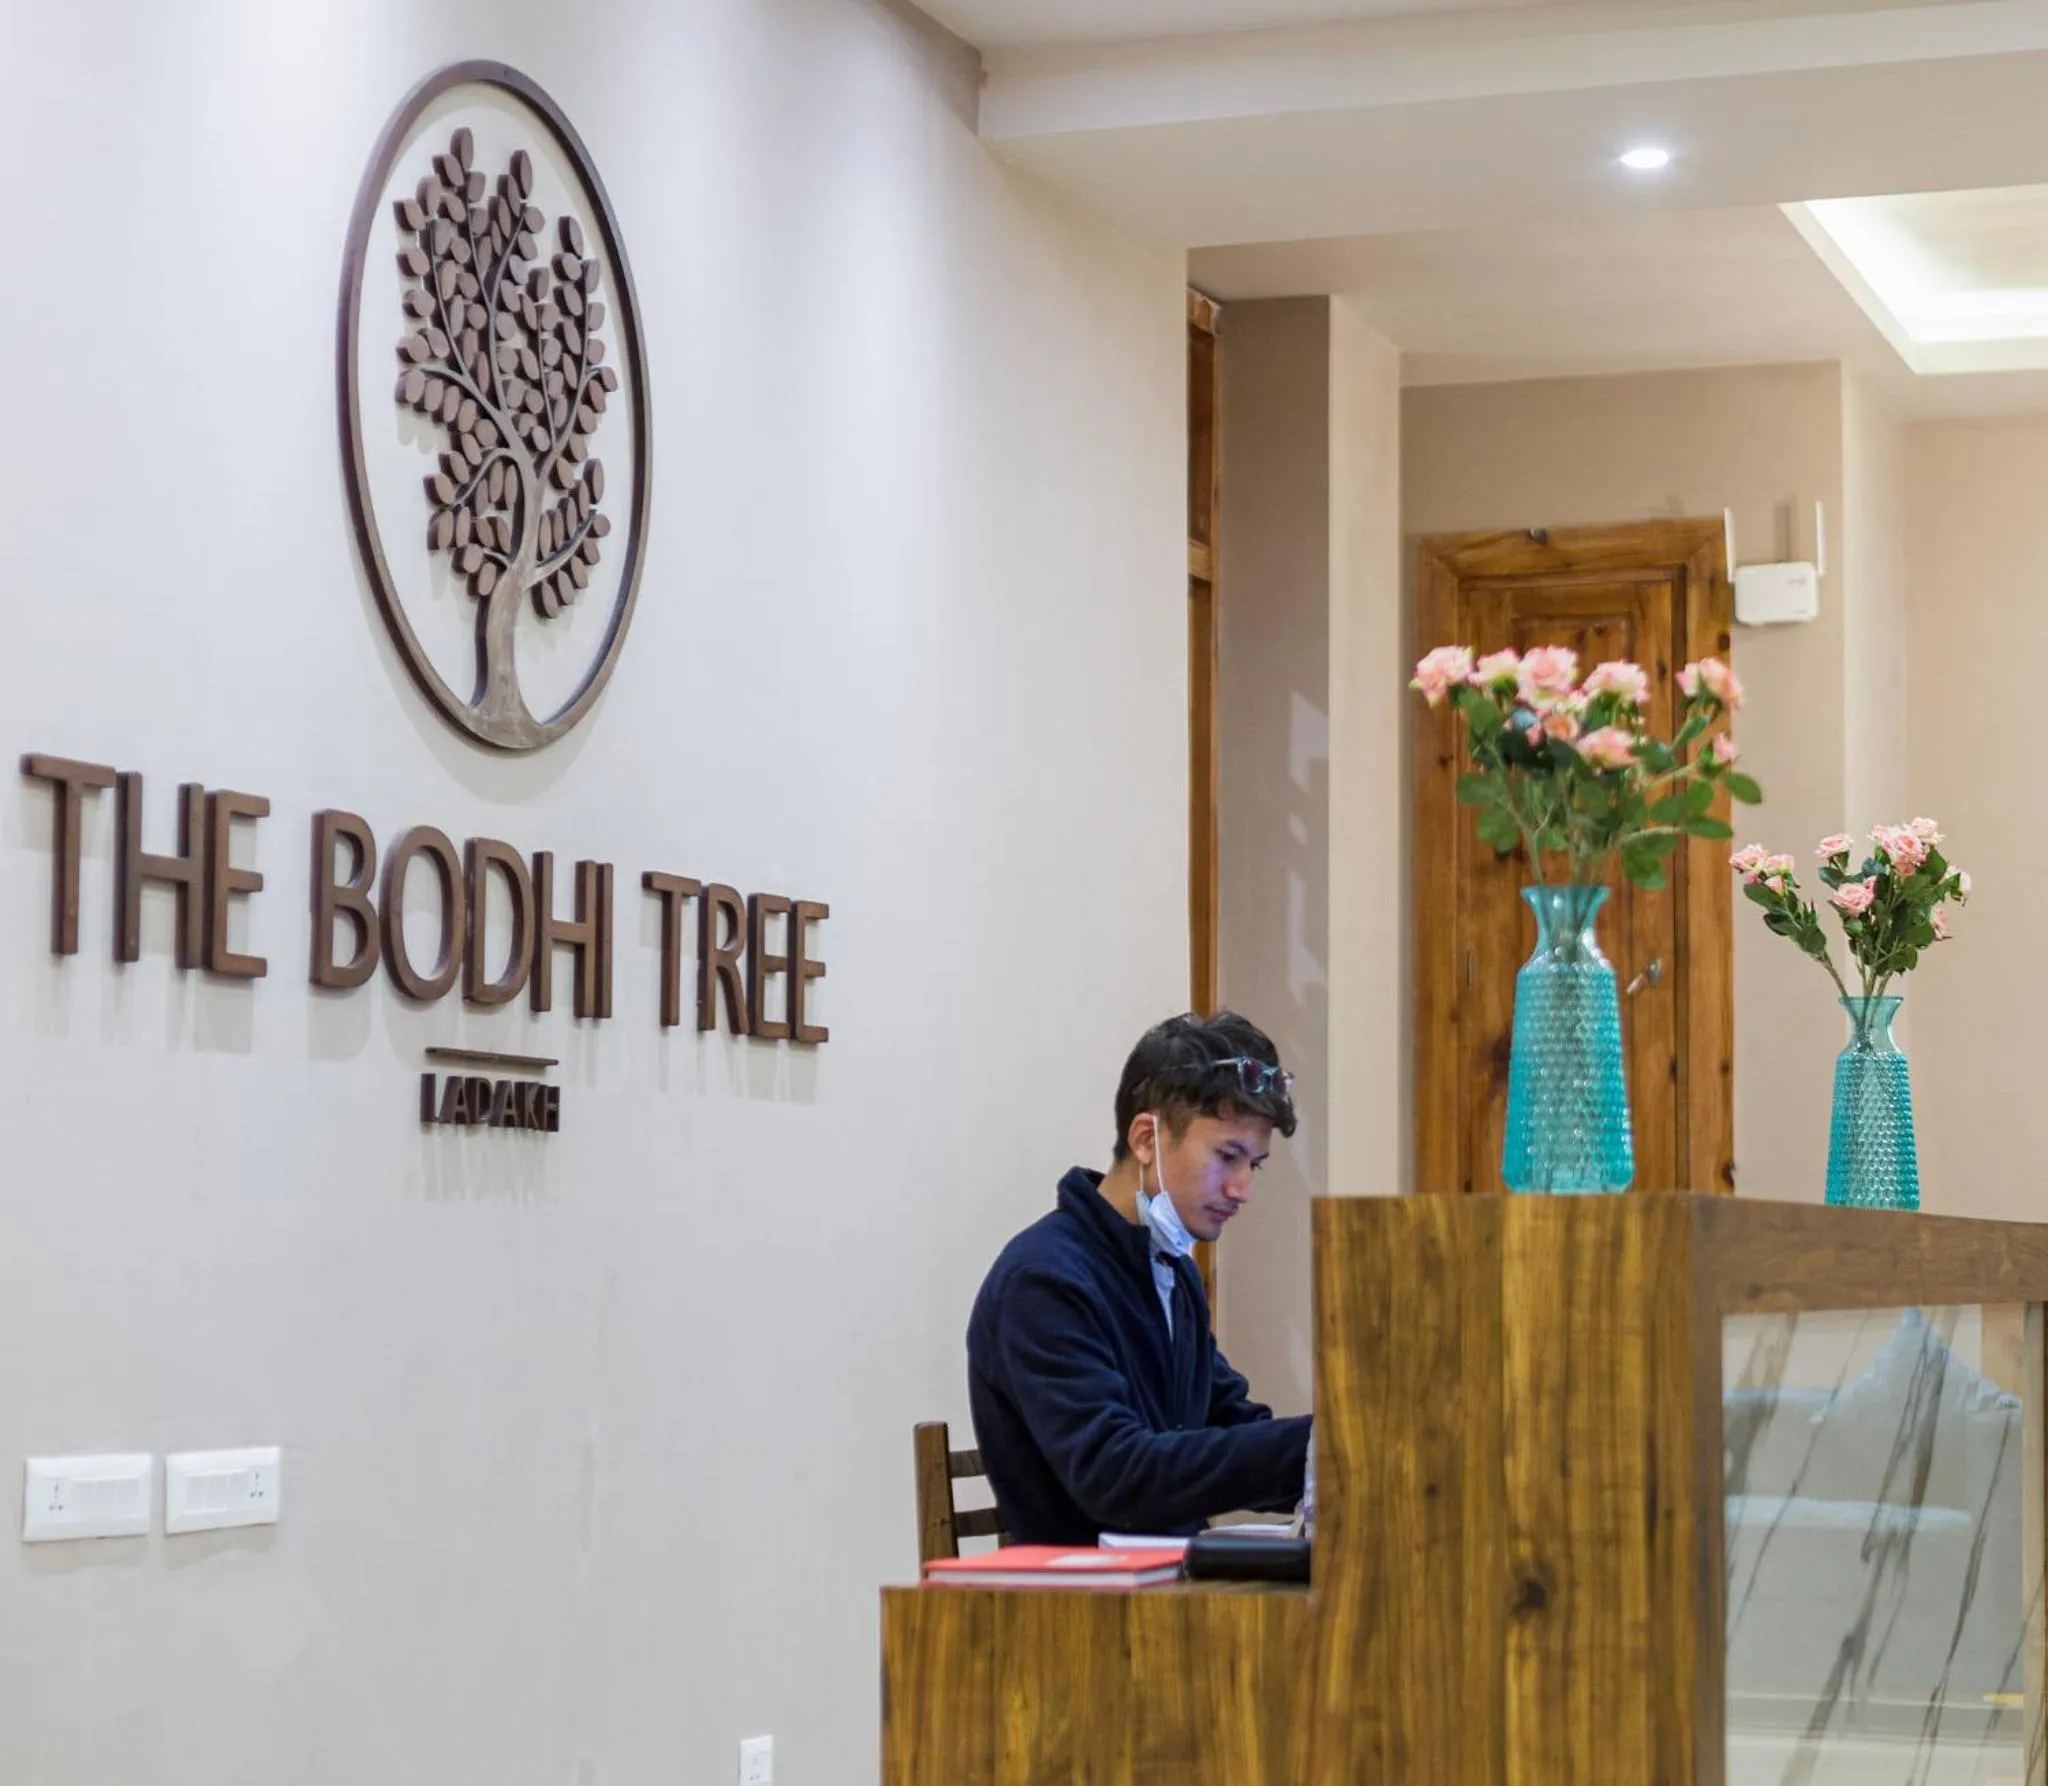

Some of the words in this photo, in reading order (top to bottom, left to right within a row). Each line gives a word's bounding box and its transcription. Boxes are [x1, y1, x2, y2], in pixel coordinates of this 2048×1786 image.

[20, 752, 270, 978] THE
[310, 808, 614, 1020] BODHI
[642, 870, 830, 1043] TREE
[420, 1073, 560, 1132] LADAKH
